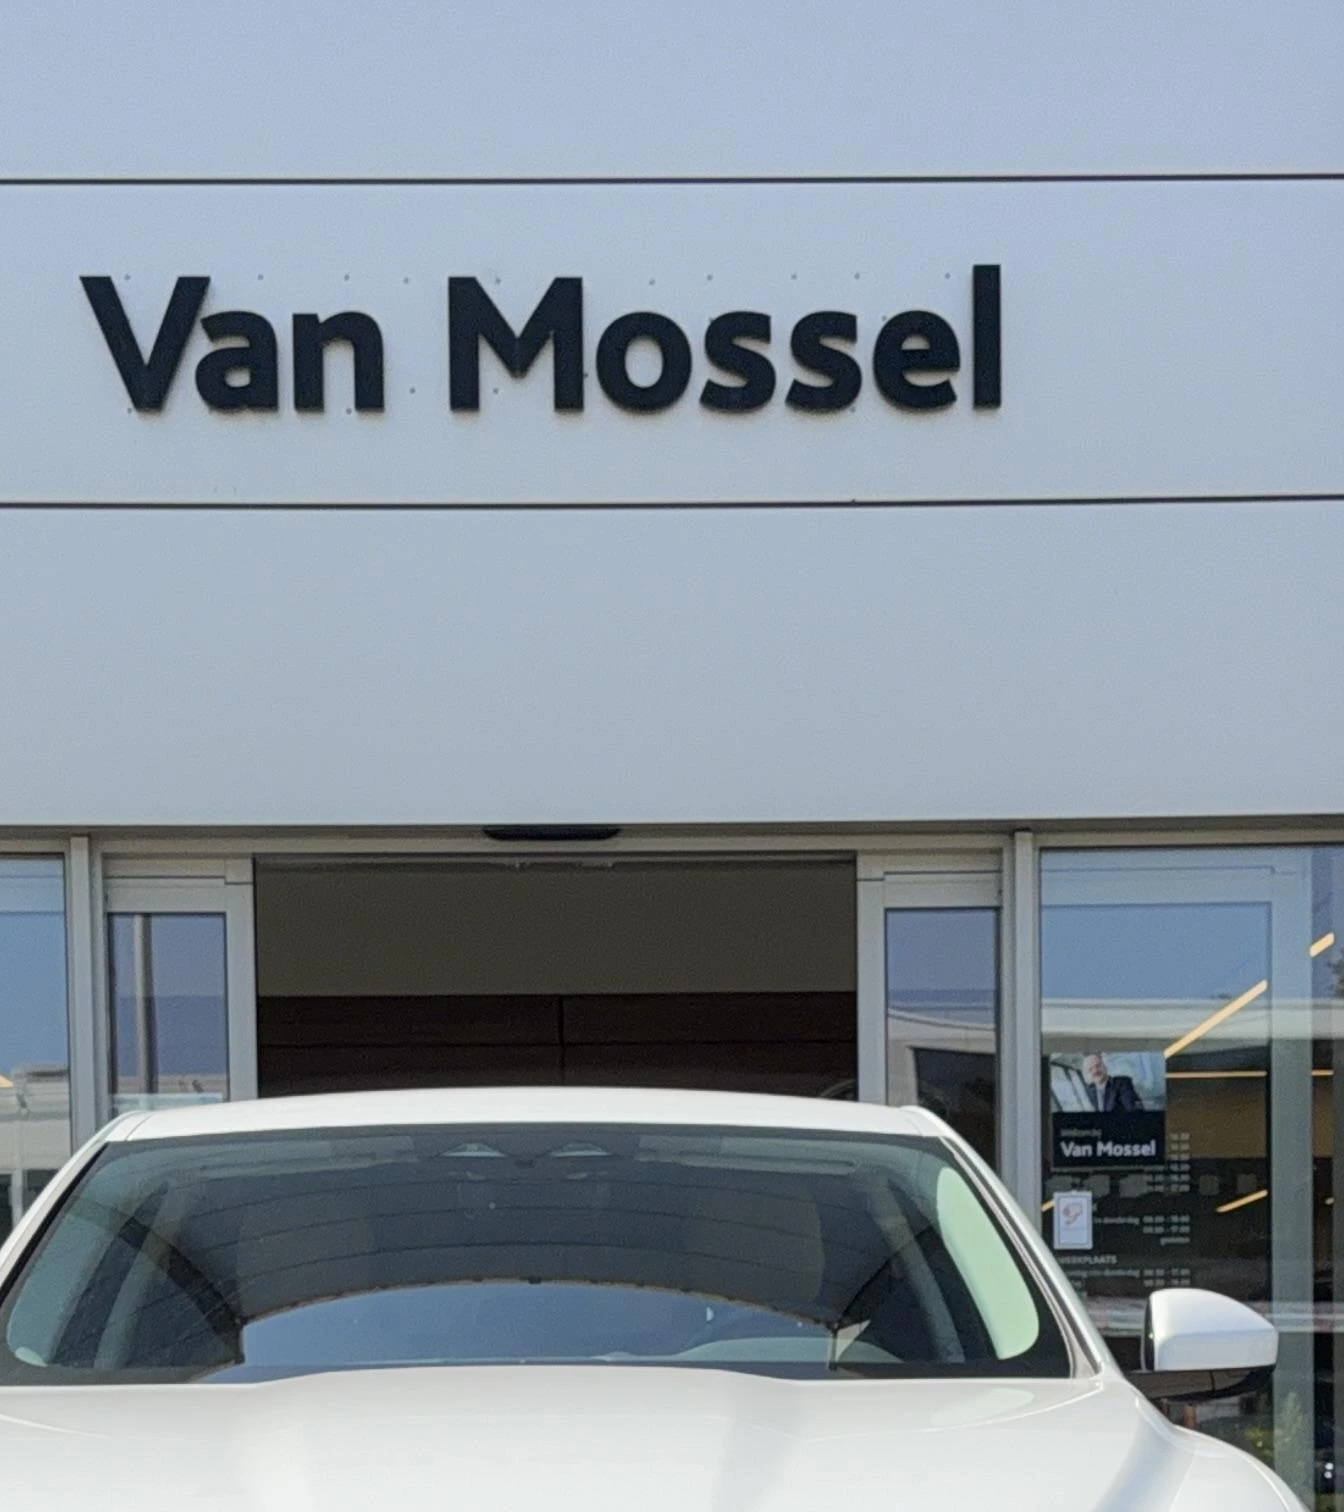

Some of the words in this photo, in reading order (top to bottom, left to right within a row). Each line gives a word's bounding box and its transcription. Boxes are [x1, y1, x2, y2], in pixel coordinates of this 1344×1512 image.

[80, 275, 385, 412] Van
[448, 264, 1002, 413] Mossel
[1060, 1141, 1093, 1157] Van
[1096, 1139, 1156, 1157] Mossel
